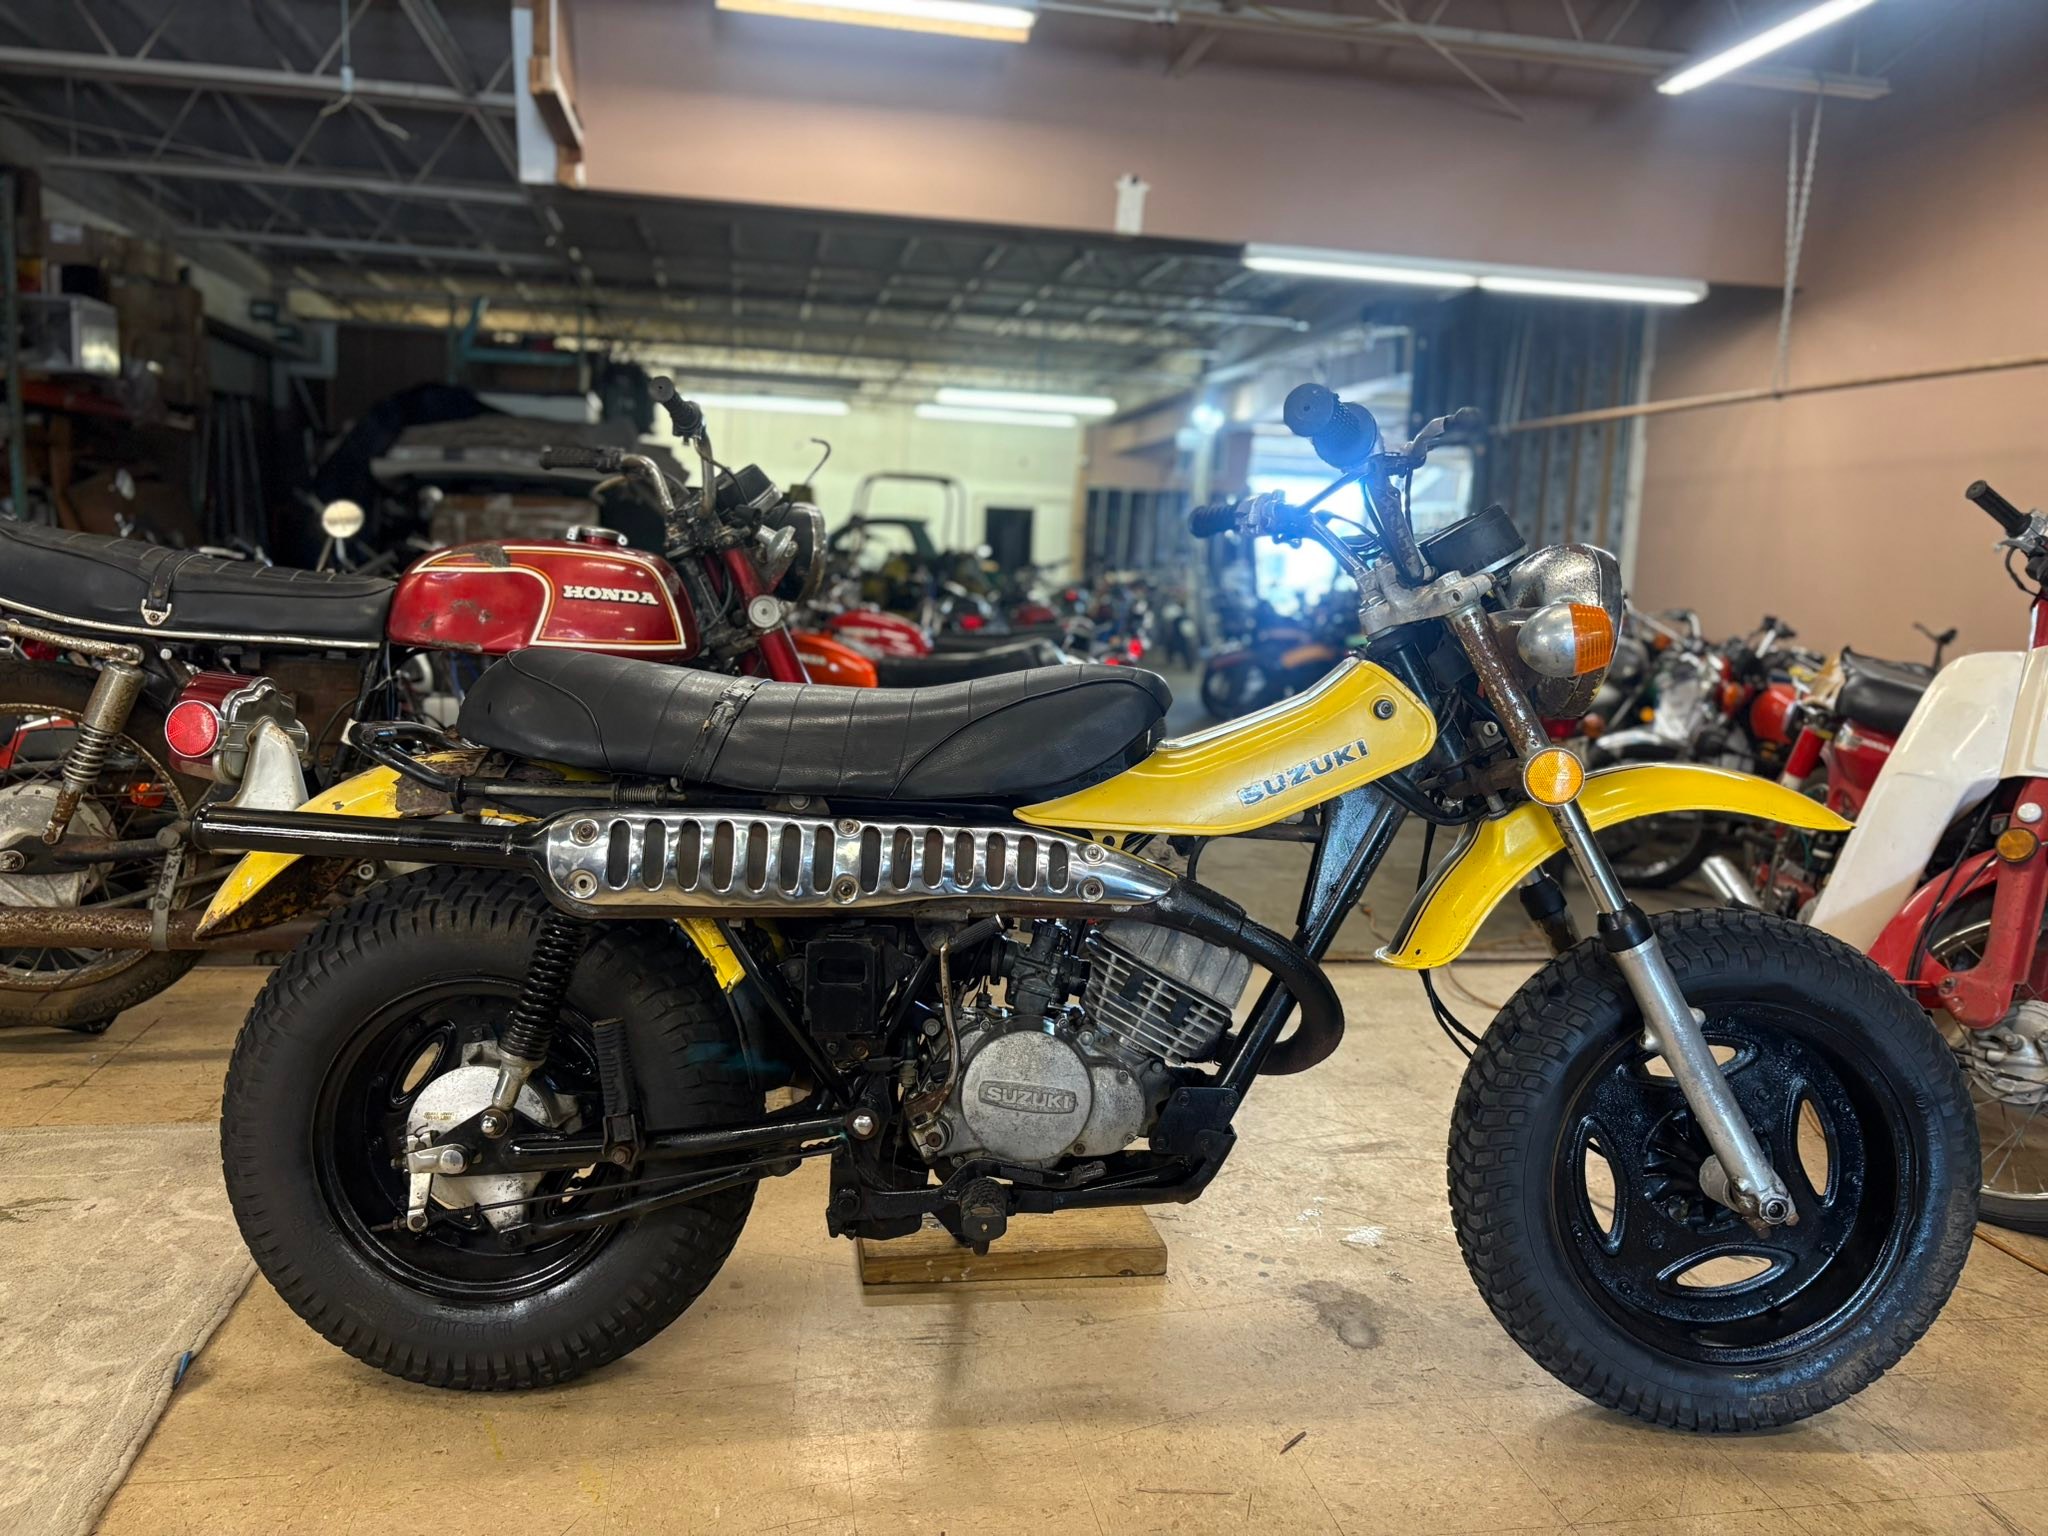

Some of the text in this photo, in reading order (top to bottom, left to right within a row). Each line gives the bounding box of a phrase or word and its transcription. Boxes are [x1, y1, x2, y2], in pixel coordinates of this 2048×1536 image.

[562, 585, 659, 606] HONDA
[1238, 739, 1369, 807] SUZUKI
[986, 1086, 1070, 1109] SUZUKI
